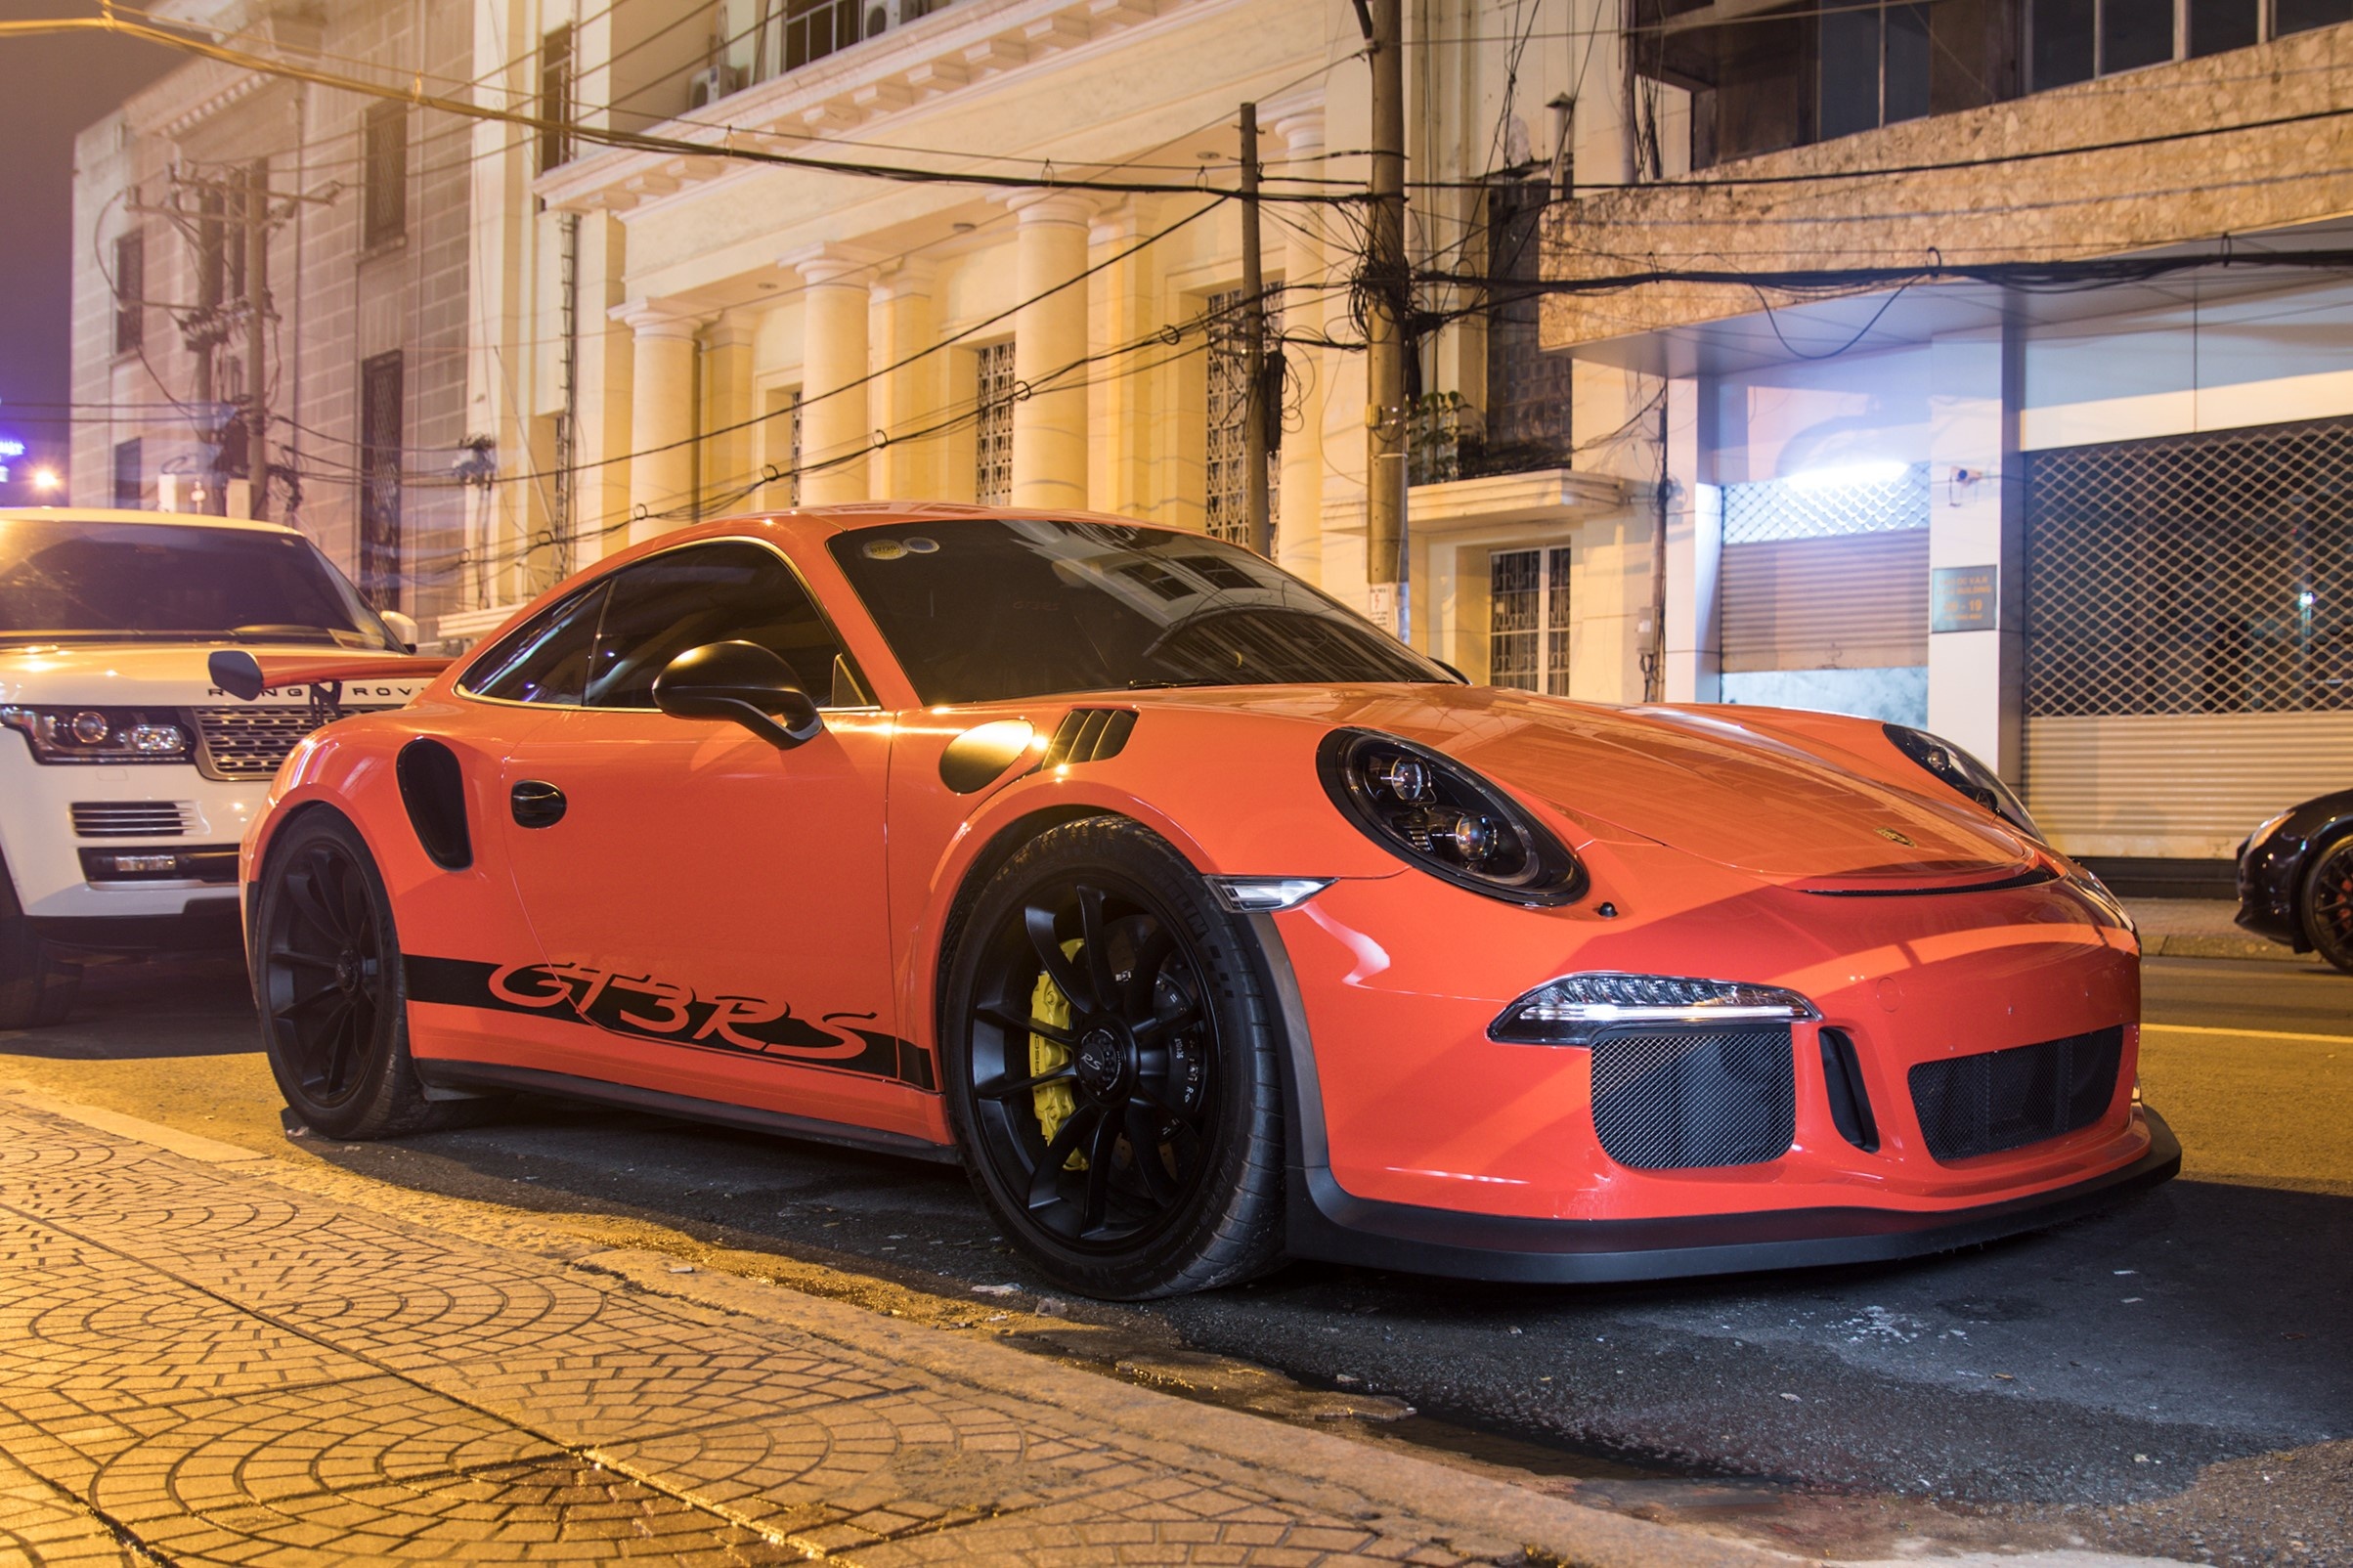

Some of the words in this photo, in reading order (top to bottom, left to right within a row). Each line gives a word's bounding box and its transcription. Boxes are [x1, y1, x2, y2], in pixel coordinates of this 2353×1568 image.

[208, 687, 302, 697] RNG
[353, 686, 425, 697] ROV
[1080, 1052, 1103, 1071] RS
